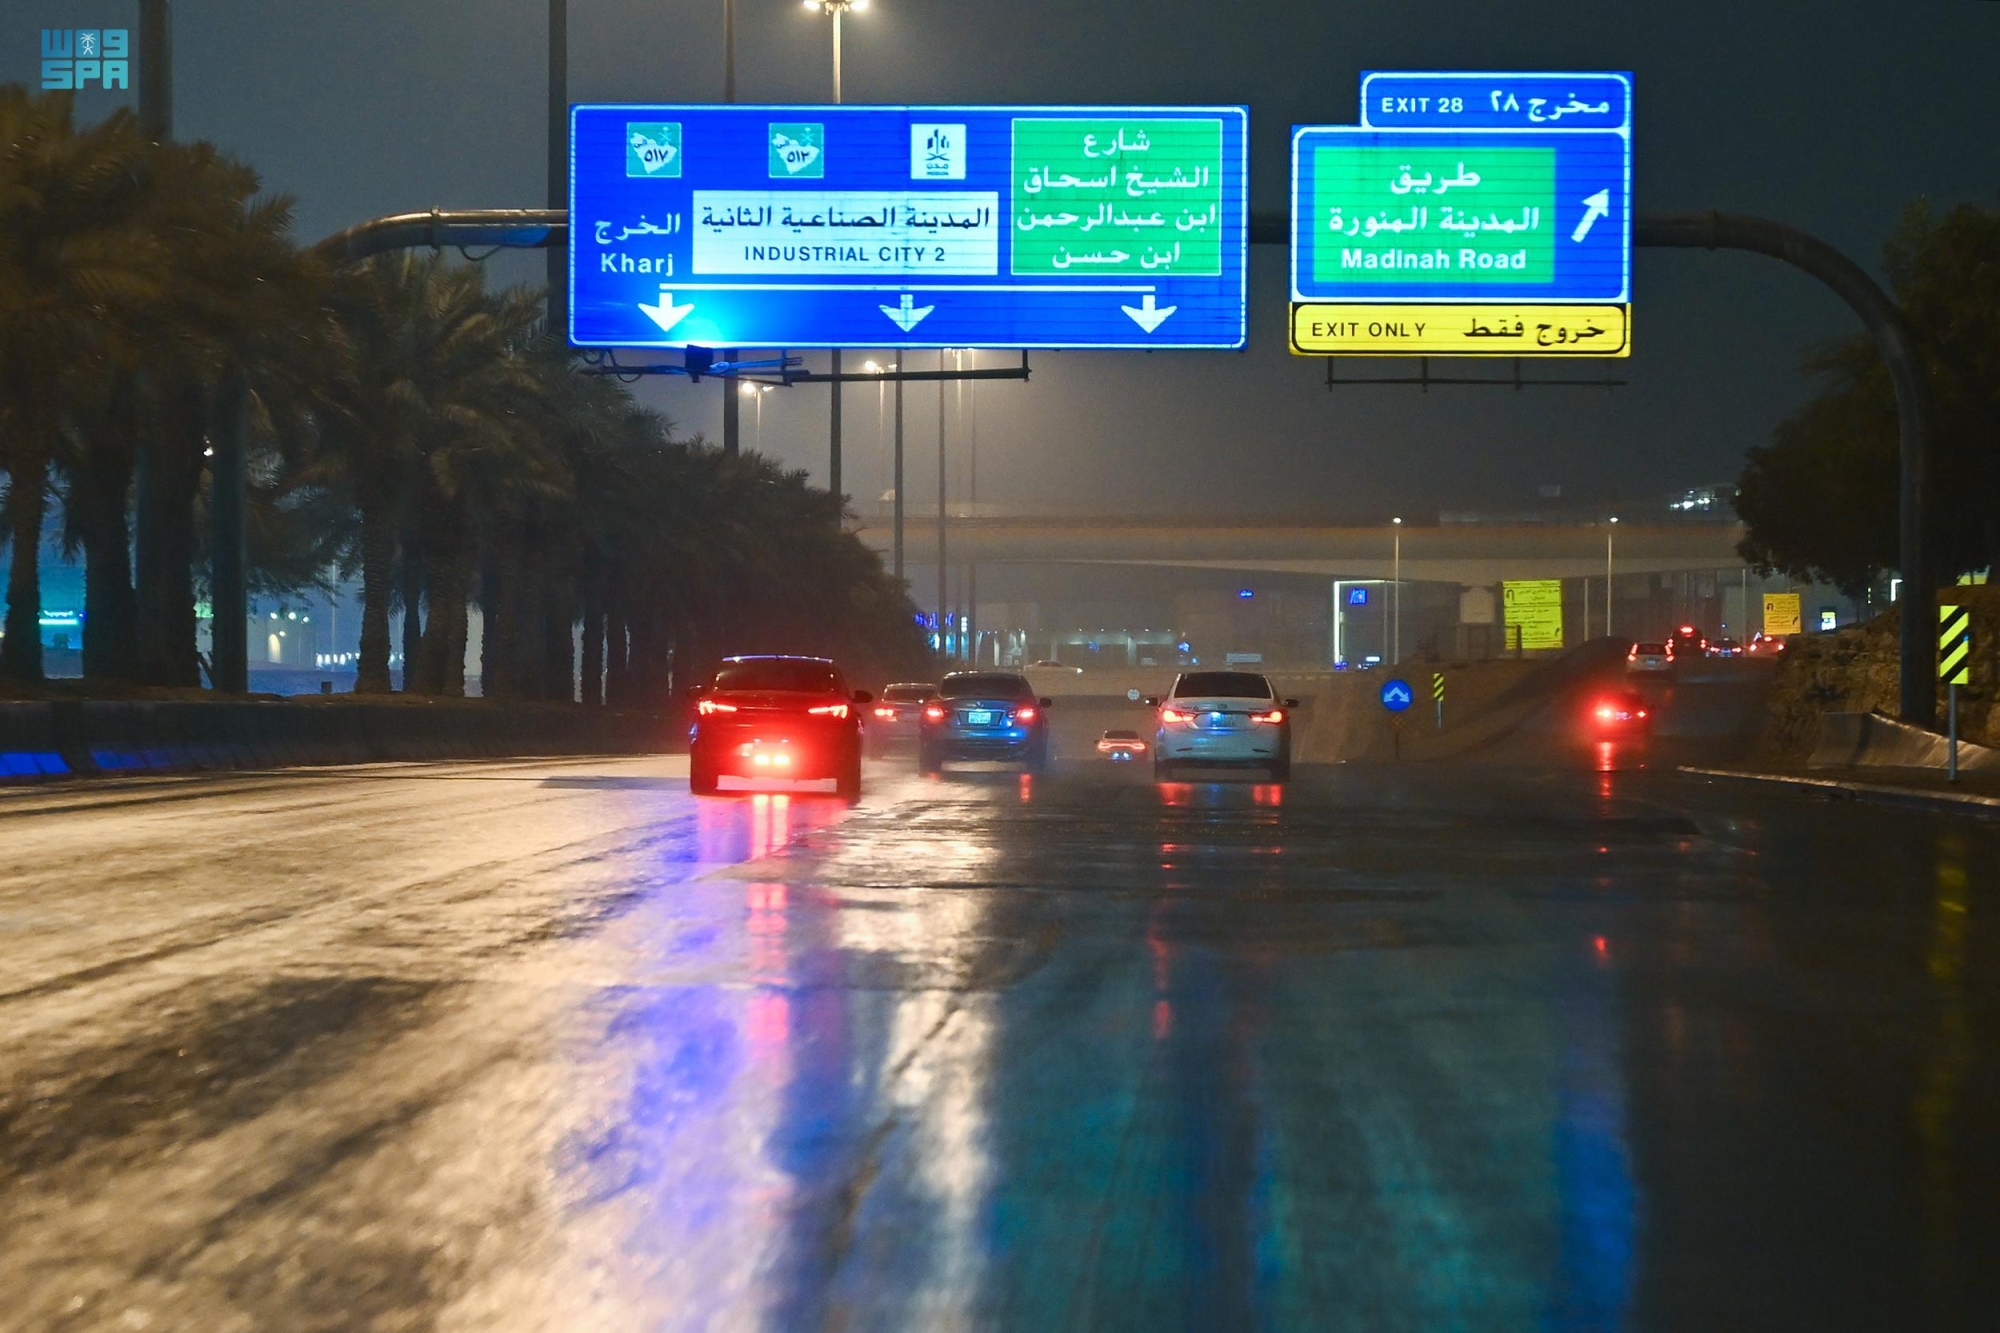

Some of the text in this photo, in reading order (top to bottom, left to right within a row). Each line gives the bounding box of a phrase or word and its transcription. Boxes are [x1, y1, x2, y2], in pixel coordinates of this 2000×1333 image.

[1382, 98, 1463, 112] EXIT 28
[1490, 90, 1610, 122] مخرج ٢٨
[644, 149, 669, 162] ٥١٧
[1084, 127, 1150, 157] شارع
[1024, 165, 1208, 196] الشيخ اسحاق
[1391, 161, 1481, 194] طريق
[596, 214, 680, 244] الخرج
[702, 206, 989, 233] المدينة الصناعية الثانية
[1018, 202, 1215, 232] ابن عبدالرحمن
[1328, 206, 1541, 238] المدينة المنورة
[602, 254, 673, 276] Kharj
[746, 247, 944, 261] INDUSTRIAL CITY 2
[1052, 241, 1180, 270] ابن حسن
[1342, 249, 1525, 268] Madinah Road
[1313, 323, 1425, 336] EXIT ONLY
[1463, 314, 1606, 347] خروج فقط
